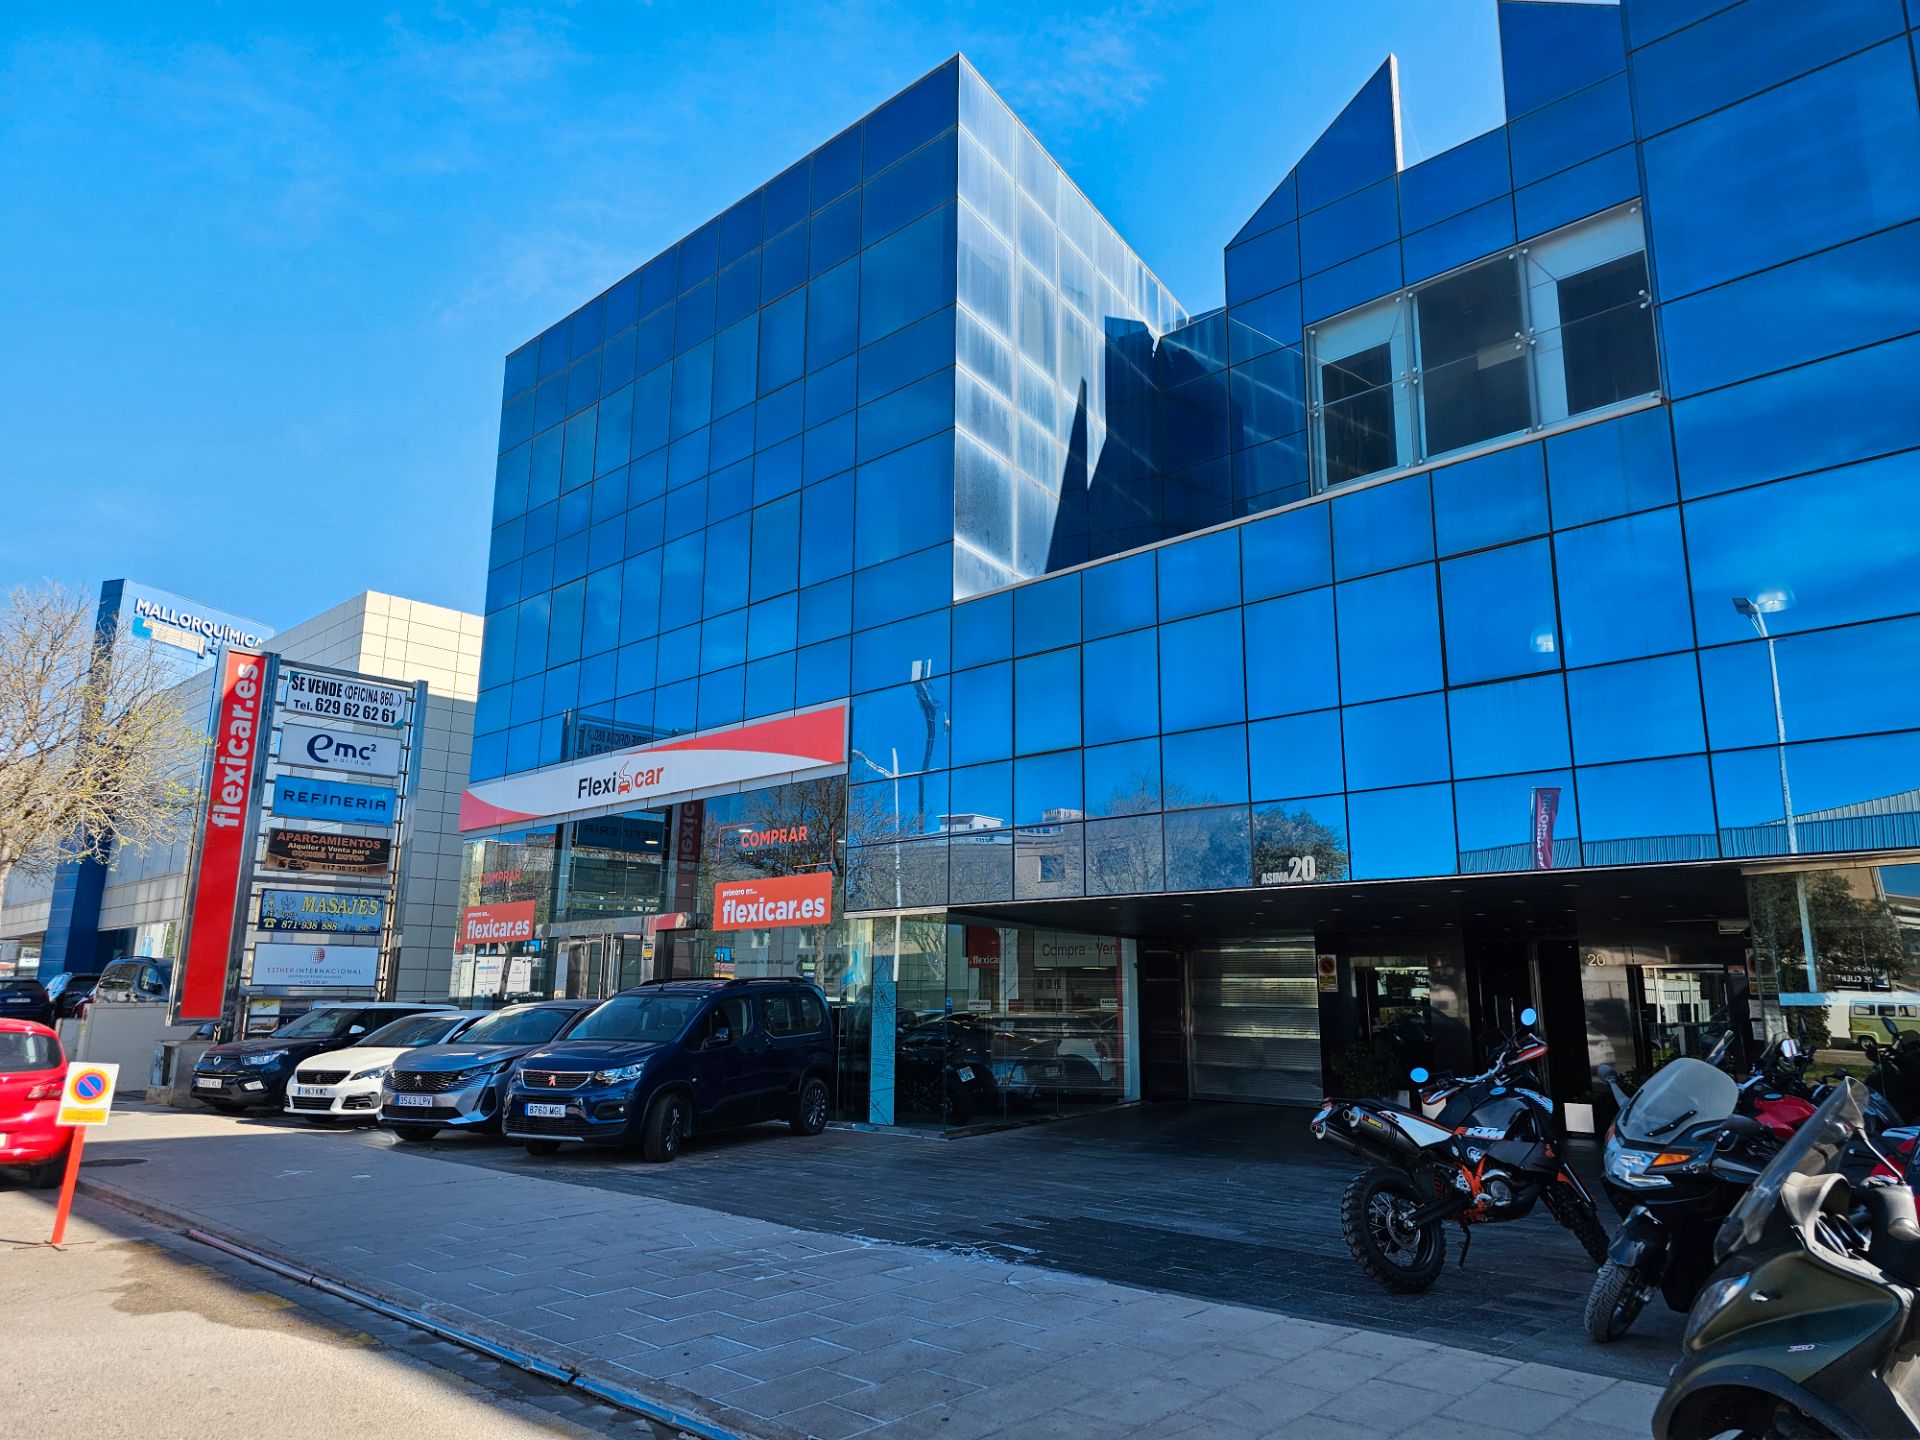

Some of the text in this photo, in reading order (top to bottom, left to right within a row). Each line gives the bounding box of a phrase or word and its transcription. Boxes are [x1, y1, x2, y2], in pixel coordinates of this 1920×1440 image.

[292, 675, 306, 692] SE
[308, 678, 343, 698] VENDE
[293, 697, 396, 723] Tel. 629 62 62 61
[212, 663, 259, 828] flexicar.es
[578, 766, 664, 799] Flexi car
[283, 790, 386, 811] REFINERIA
[277, 832, 381, 849] APARCAMIENTOS
[741, 825, 808, 848] COMPRAR
[480, 868, 521, 885] COMPRAR
[1288, 855, 1316, 881] 20
[722, 888, 745, 898] primero
[301, 895, 379, 916] MASAJES
[722, 897, 826, 924] flexicar.es
[281, 920, 298, 929] 871
[301, 921, 317, 930] 938
[321, 922, 338, 931] 888
[467, 919, 530, 940] flexicar.es
[1042, 943, 1086, 959] Compra
[1587, 953, 1606, 967] 20
[295, 967, 361, 975] INTERNACIONAL
[1466, 1126, 1506, 1140] KTM
